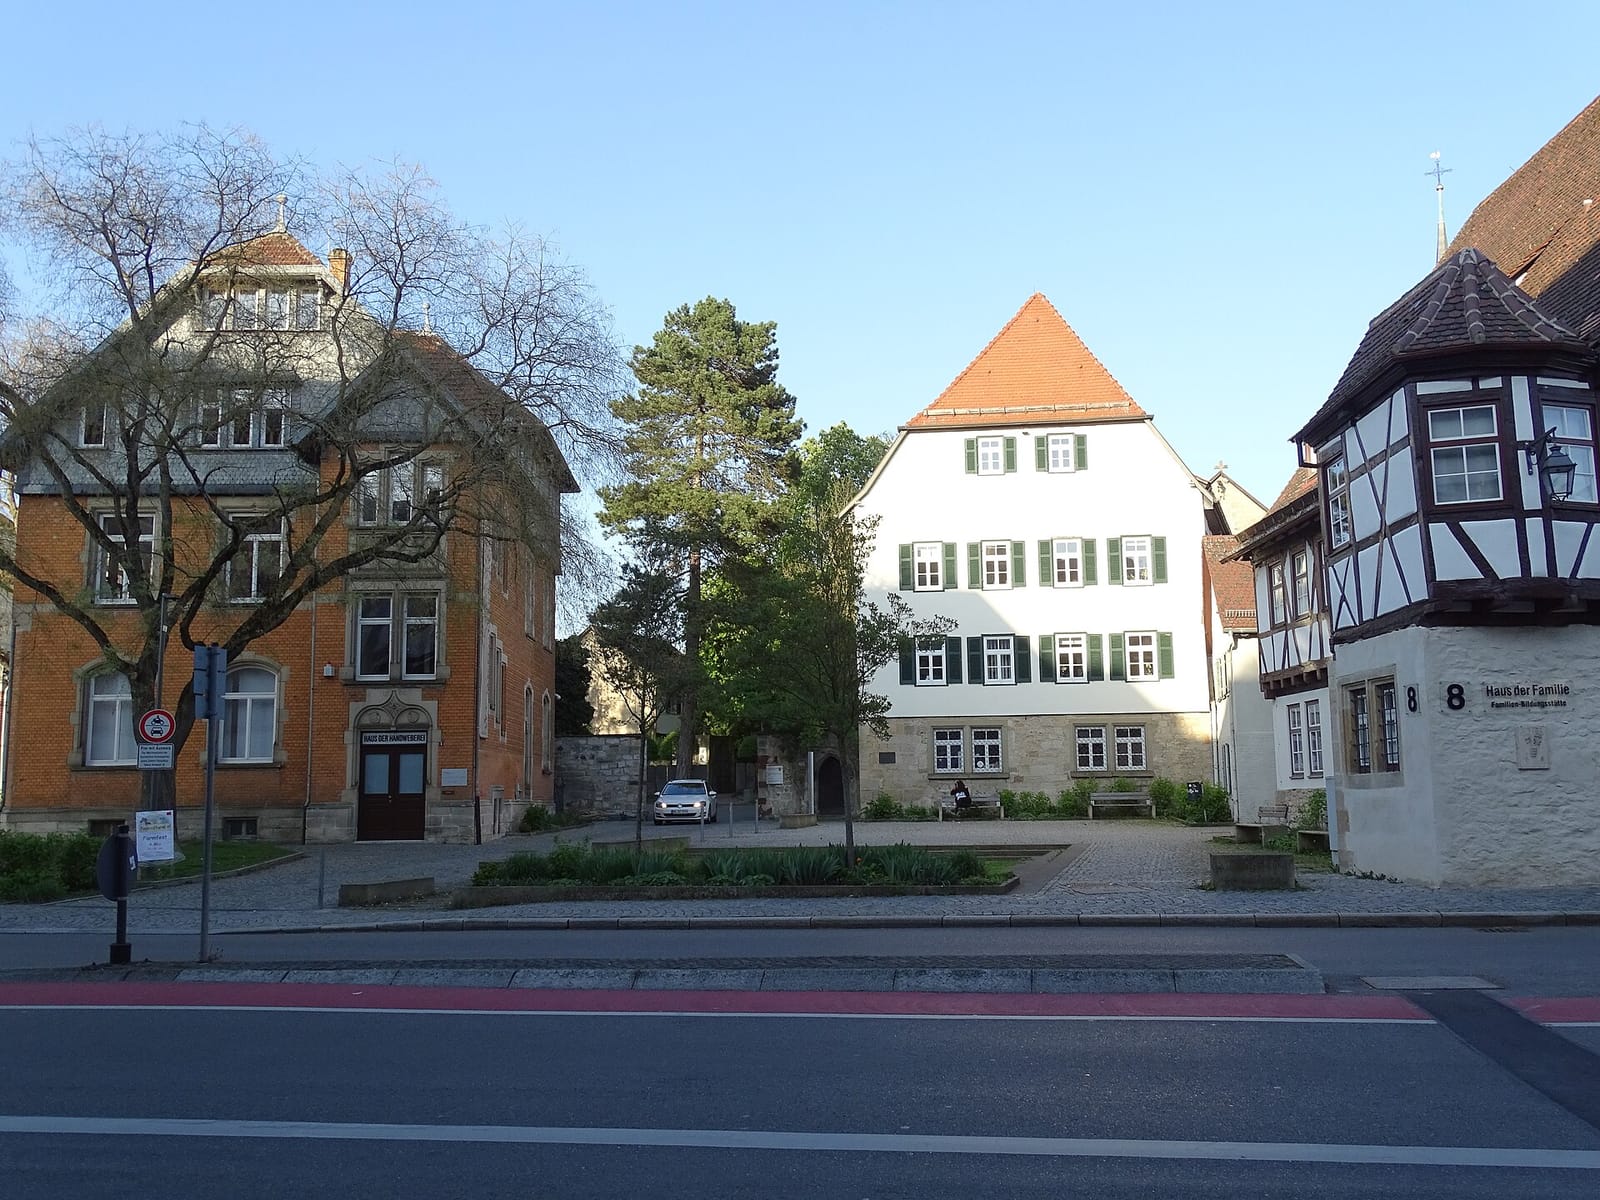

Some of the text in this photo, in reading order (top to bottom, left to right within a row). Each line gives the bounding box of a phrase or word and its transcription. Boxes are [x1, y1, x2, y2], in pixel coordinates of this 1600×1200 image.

[1407, 686, 1418, 712] 8
[1446, 683, 1466, 710] 8
[1486, 683, 1570, 697] Haus der Familie
[363, 733, 426, 743] HAUS DER HANDWEBEREI
